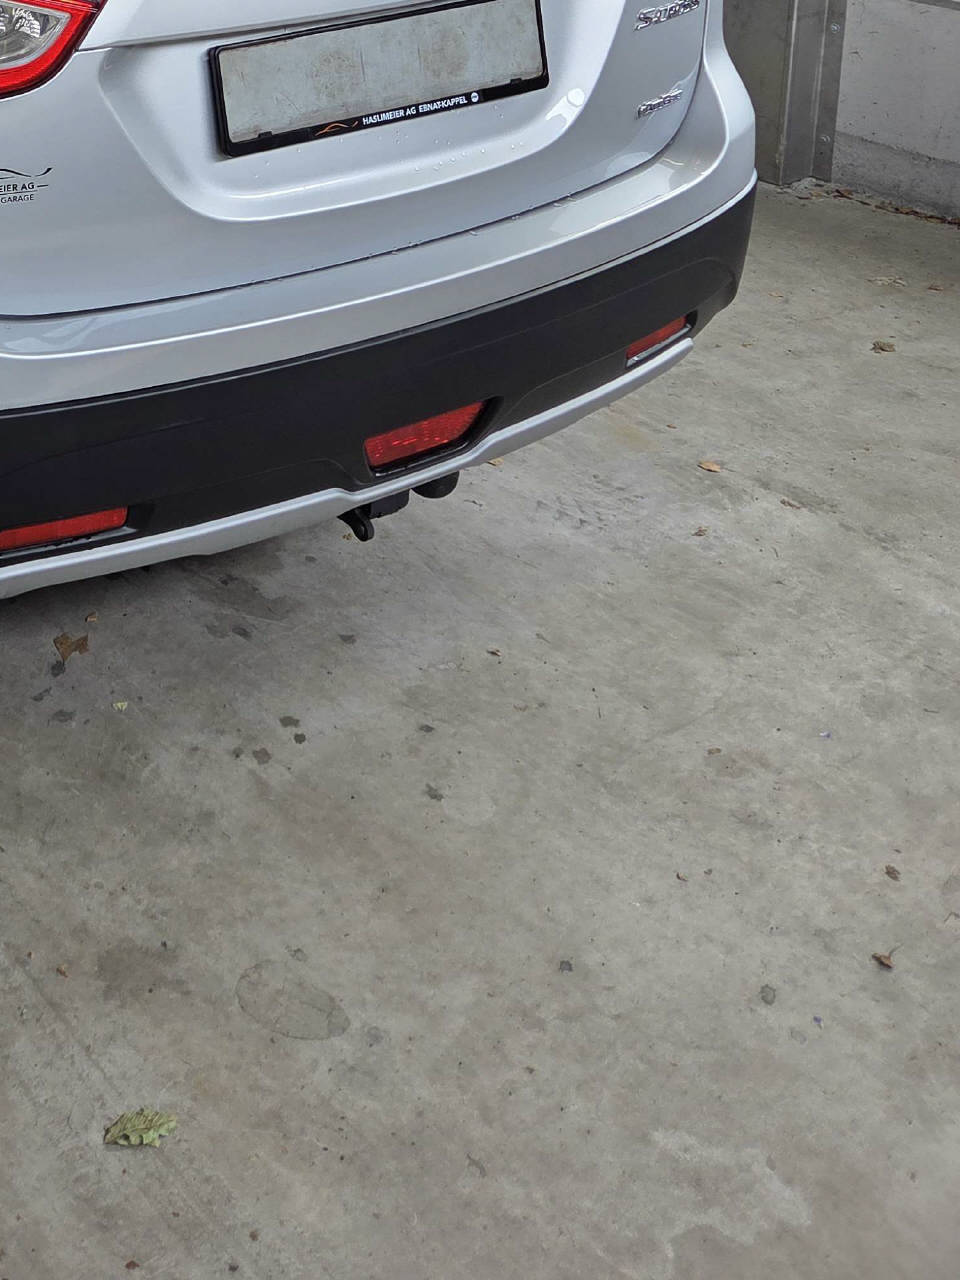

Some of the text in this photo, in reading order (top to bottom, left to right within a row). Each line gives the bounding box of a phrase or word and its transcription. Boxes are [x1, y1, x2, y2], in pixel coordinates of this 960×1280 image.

[362, 110, 405, 125] HASLIMEIER
[405, 106, 417, 116] AG
[20, 181, 35, 191] AG
[0, 193, 35, 204] GARAGE
